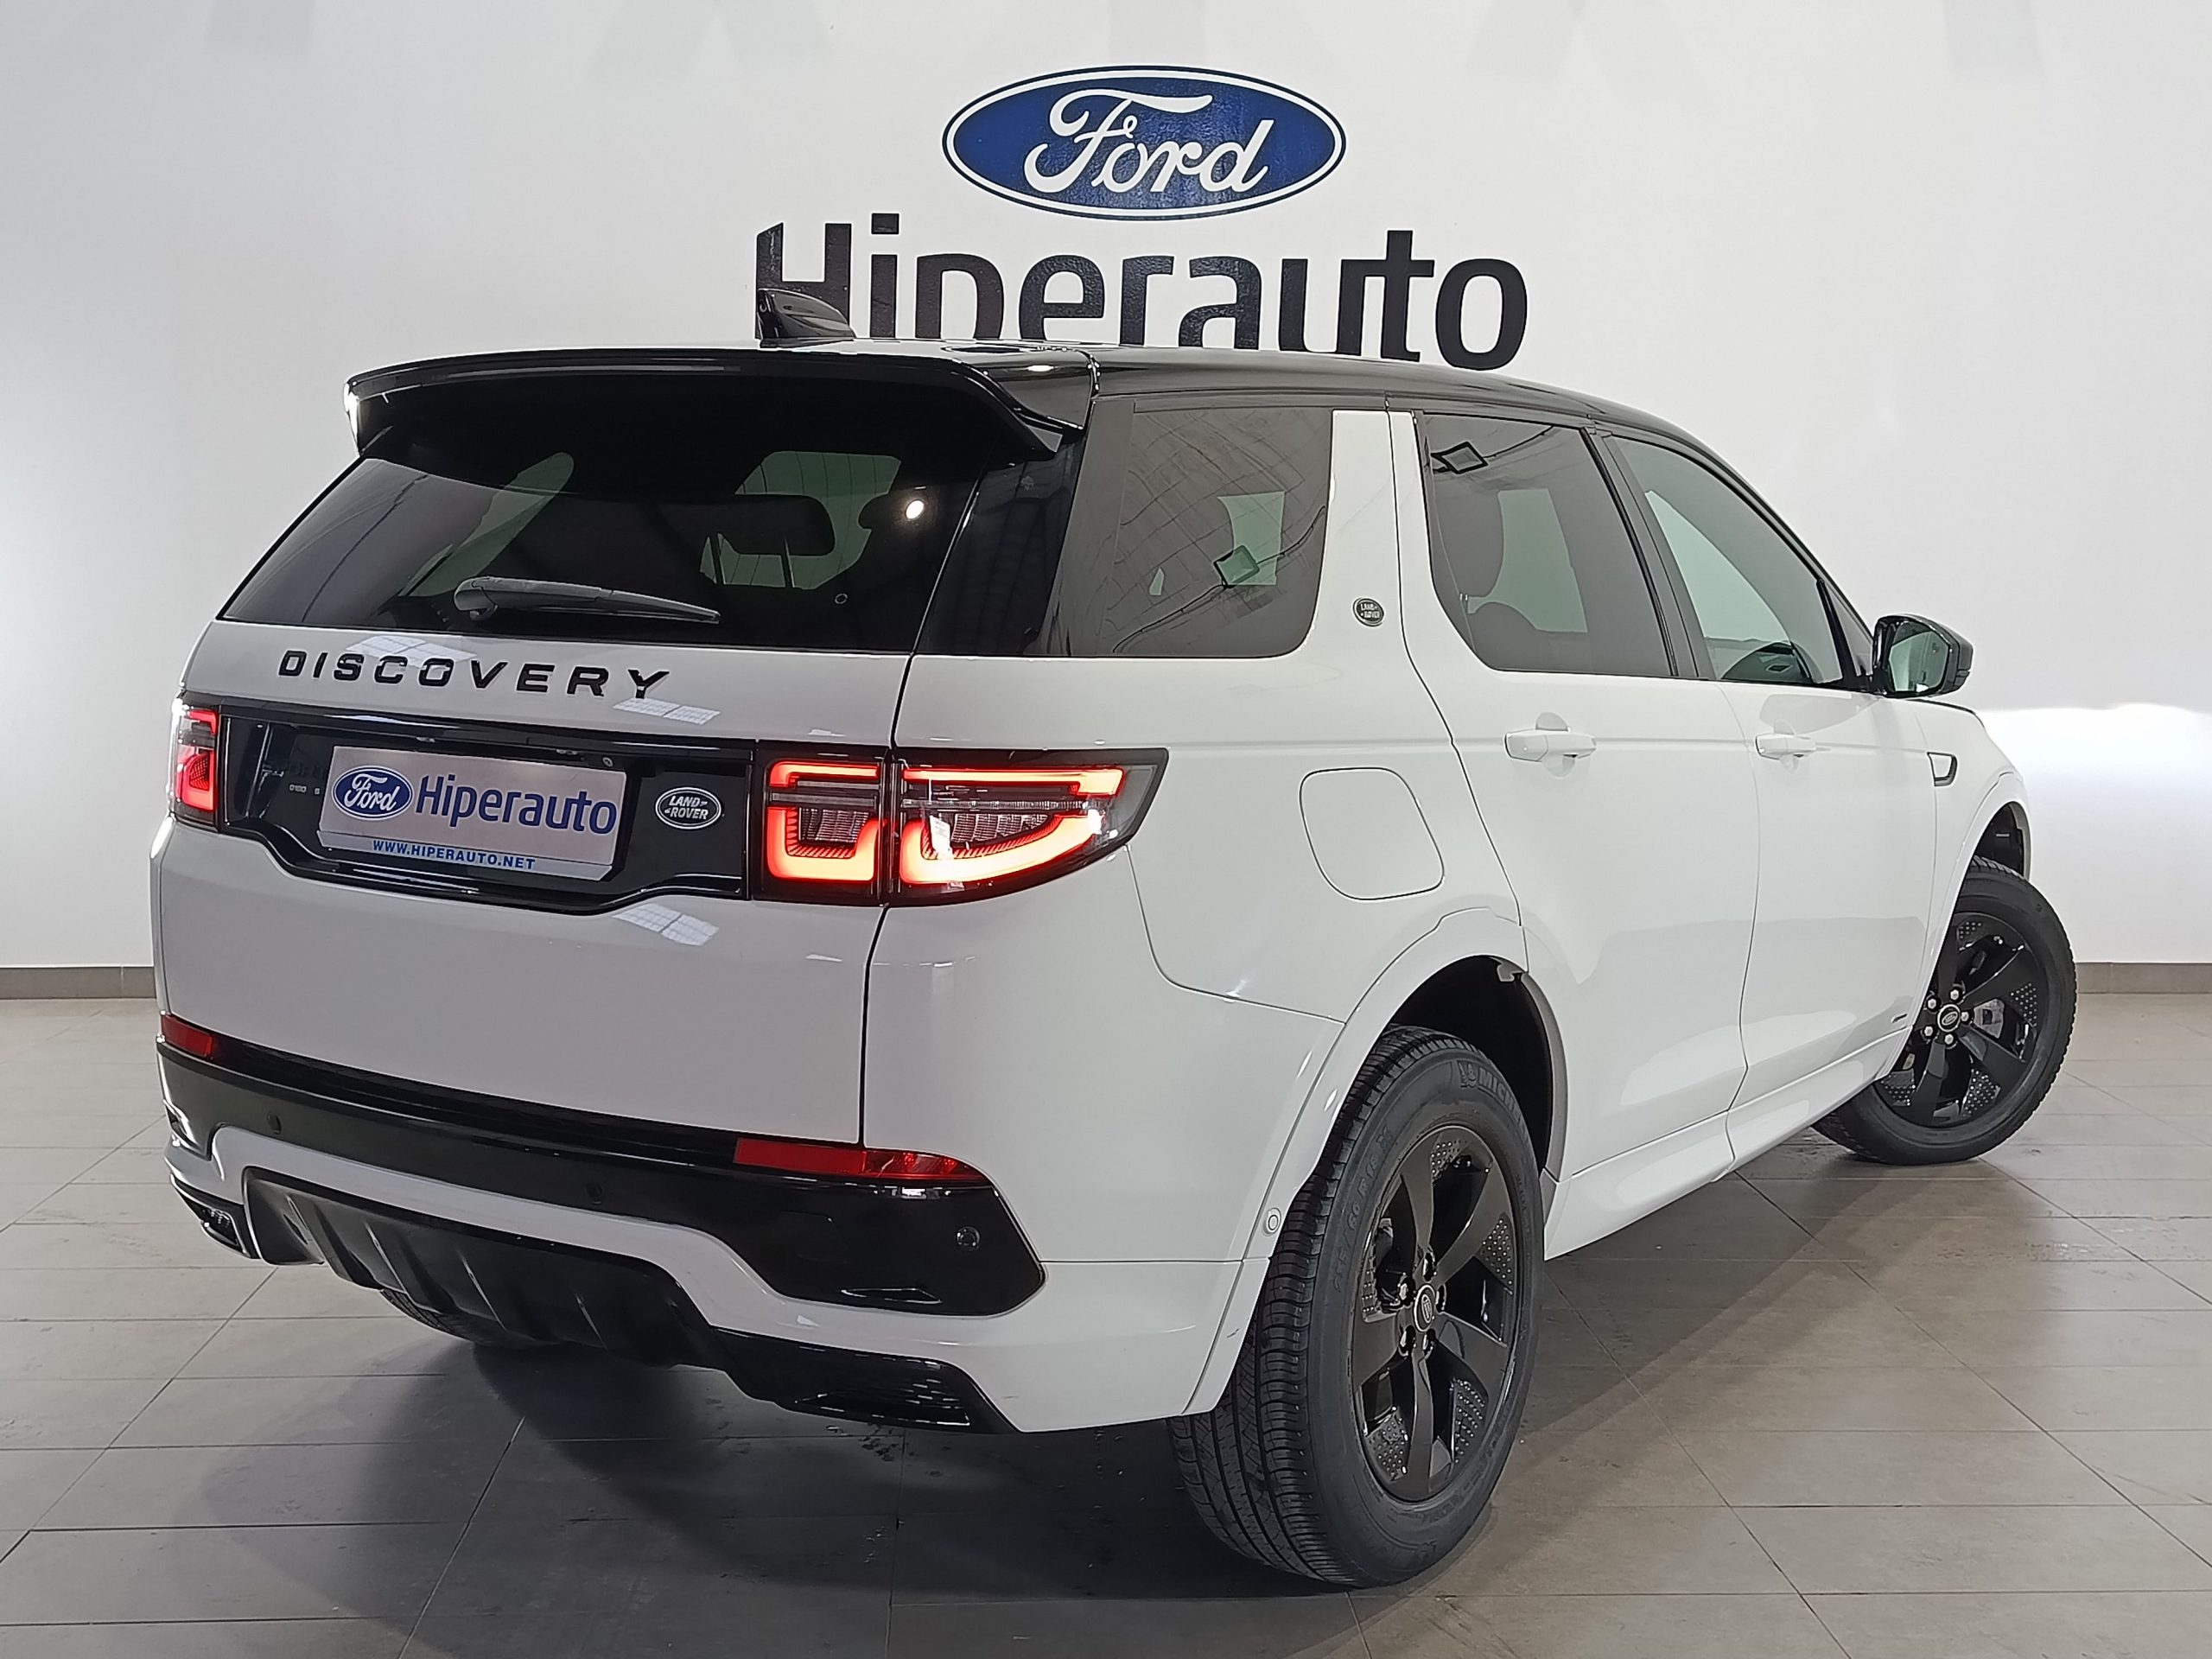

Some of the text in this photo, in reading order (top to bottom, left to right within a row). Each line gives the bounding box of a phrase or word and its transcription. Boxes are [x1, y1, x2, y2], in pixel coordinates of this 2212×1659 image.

[1024, 88, 1275, 194] Ford
[755, 213, 1529, 372] Hiperauto
[277, 650, 671, 699] DISCOVERY
[345, 773, 618, 835] Ford Hiperauto
[669, 795, 701, 807] LAND
[670, 807, 709, 820] ROVER
[372, 840, 536, 870] WWW.HIPERAUTO.NET
